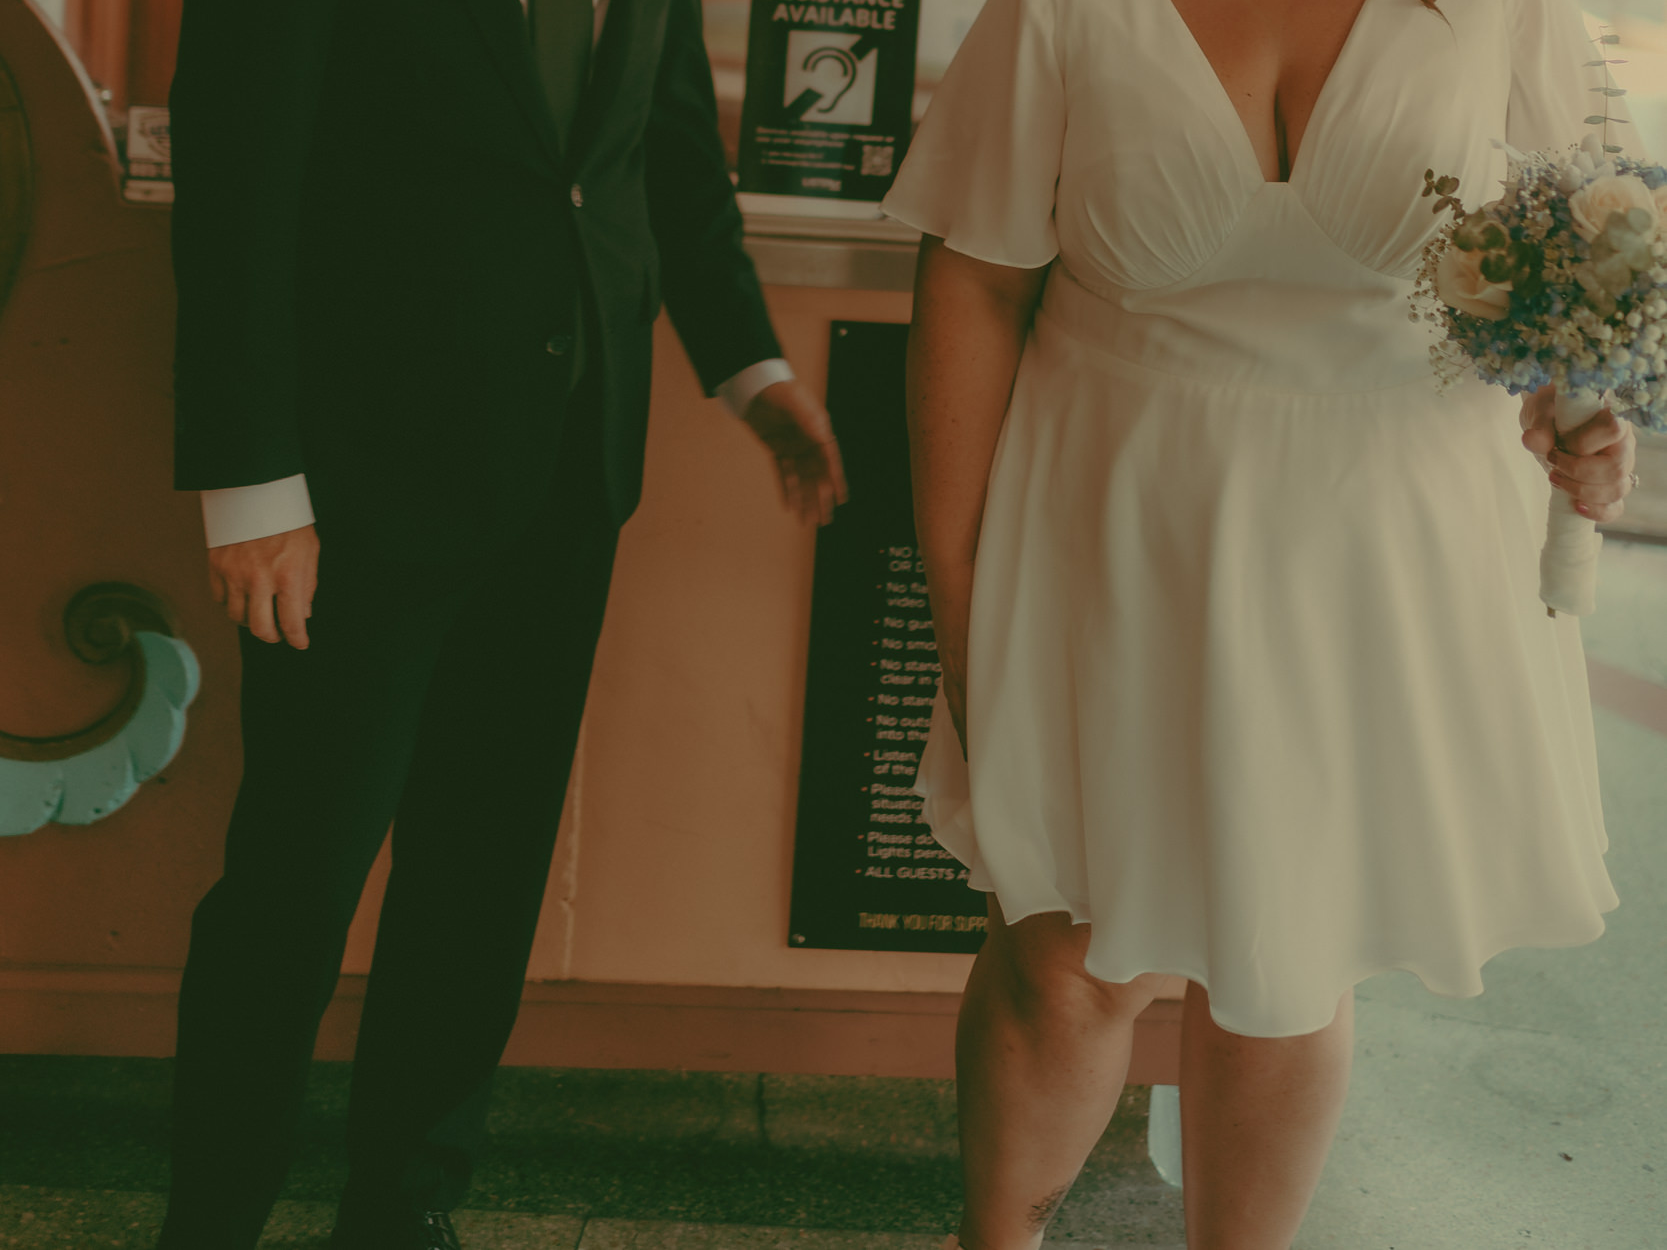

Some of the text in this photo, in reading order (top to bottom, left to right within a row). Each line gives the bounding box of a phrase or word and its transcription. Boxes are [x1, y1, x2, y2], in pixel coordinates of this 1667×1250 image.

[772, 3, 897, 30] AVAILABLE
[886, 582, 907, 593] No
[887, 597, 926, 608] video
[883, 617, 905, 628] No
[882, 638, 903, 650] No
[880, 659, 902, 671] No
[878, 694, 900, 706] No
[876, 715, 898, 727] No
[873, 763, 890, 775] of
[867, 831, 913, 845] Please
[867, 846, 912, 859] Lights
[864, 866, 894, 879] ALL
[896, 866, 955, 881] GUESTS
[858, 912, 899, 929] THANK
[901, 914, 929, 930] YOU
